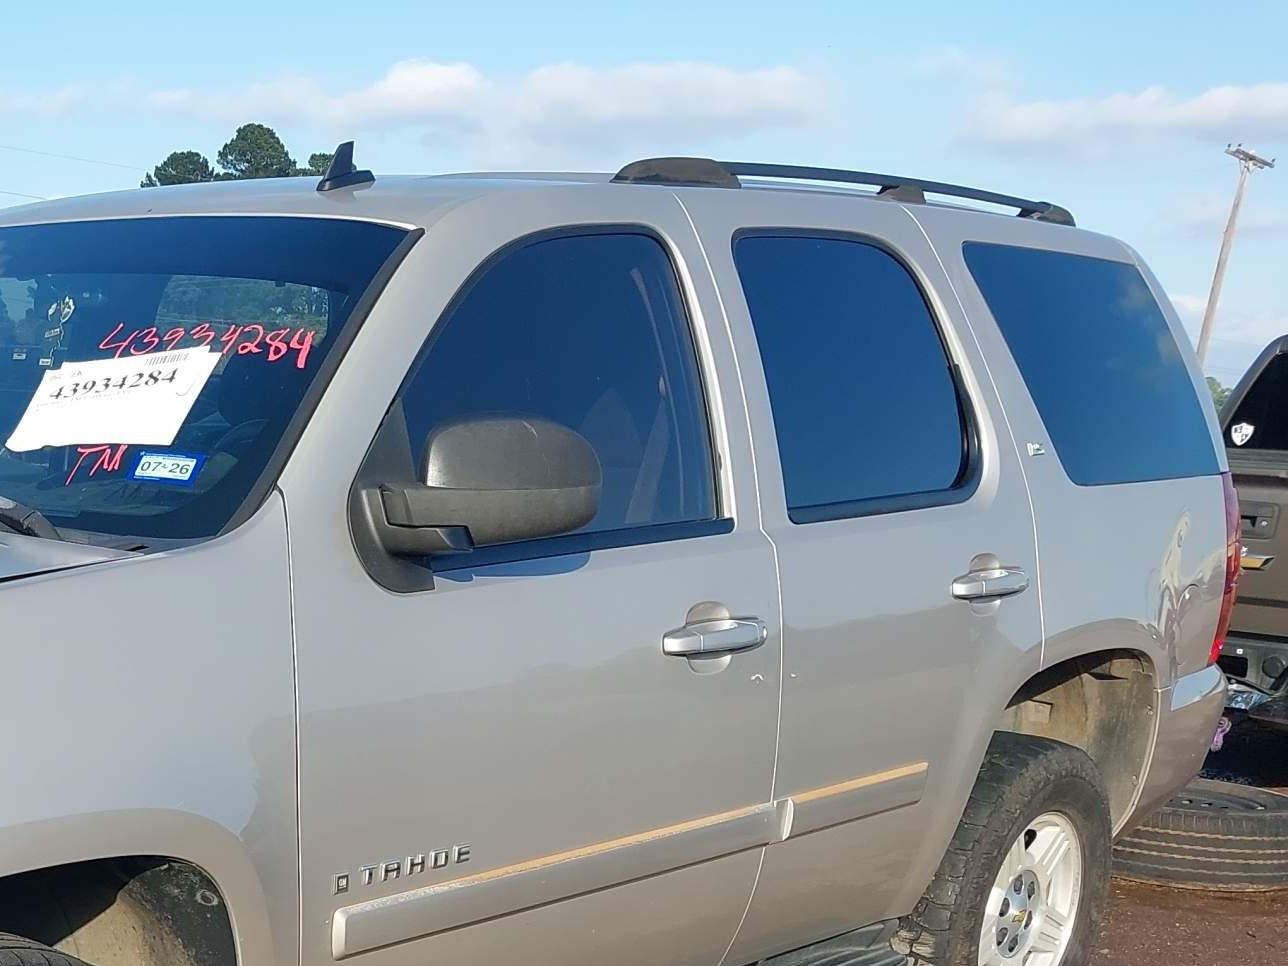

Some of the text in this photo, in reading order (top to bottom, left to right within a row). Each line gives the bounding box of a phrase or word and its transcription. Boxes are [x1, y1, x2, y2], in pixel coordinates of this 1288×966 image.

[99, 322, 315, 369] 43934284
[49, 367, 179, 400] 43934284
[359, 842, 472, 886] TAHOE
